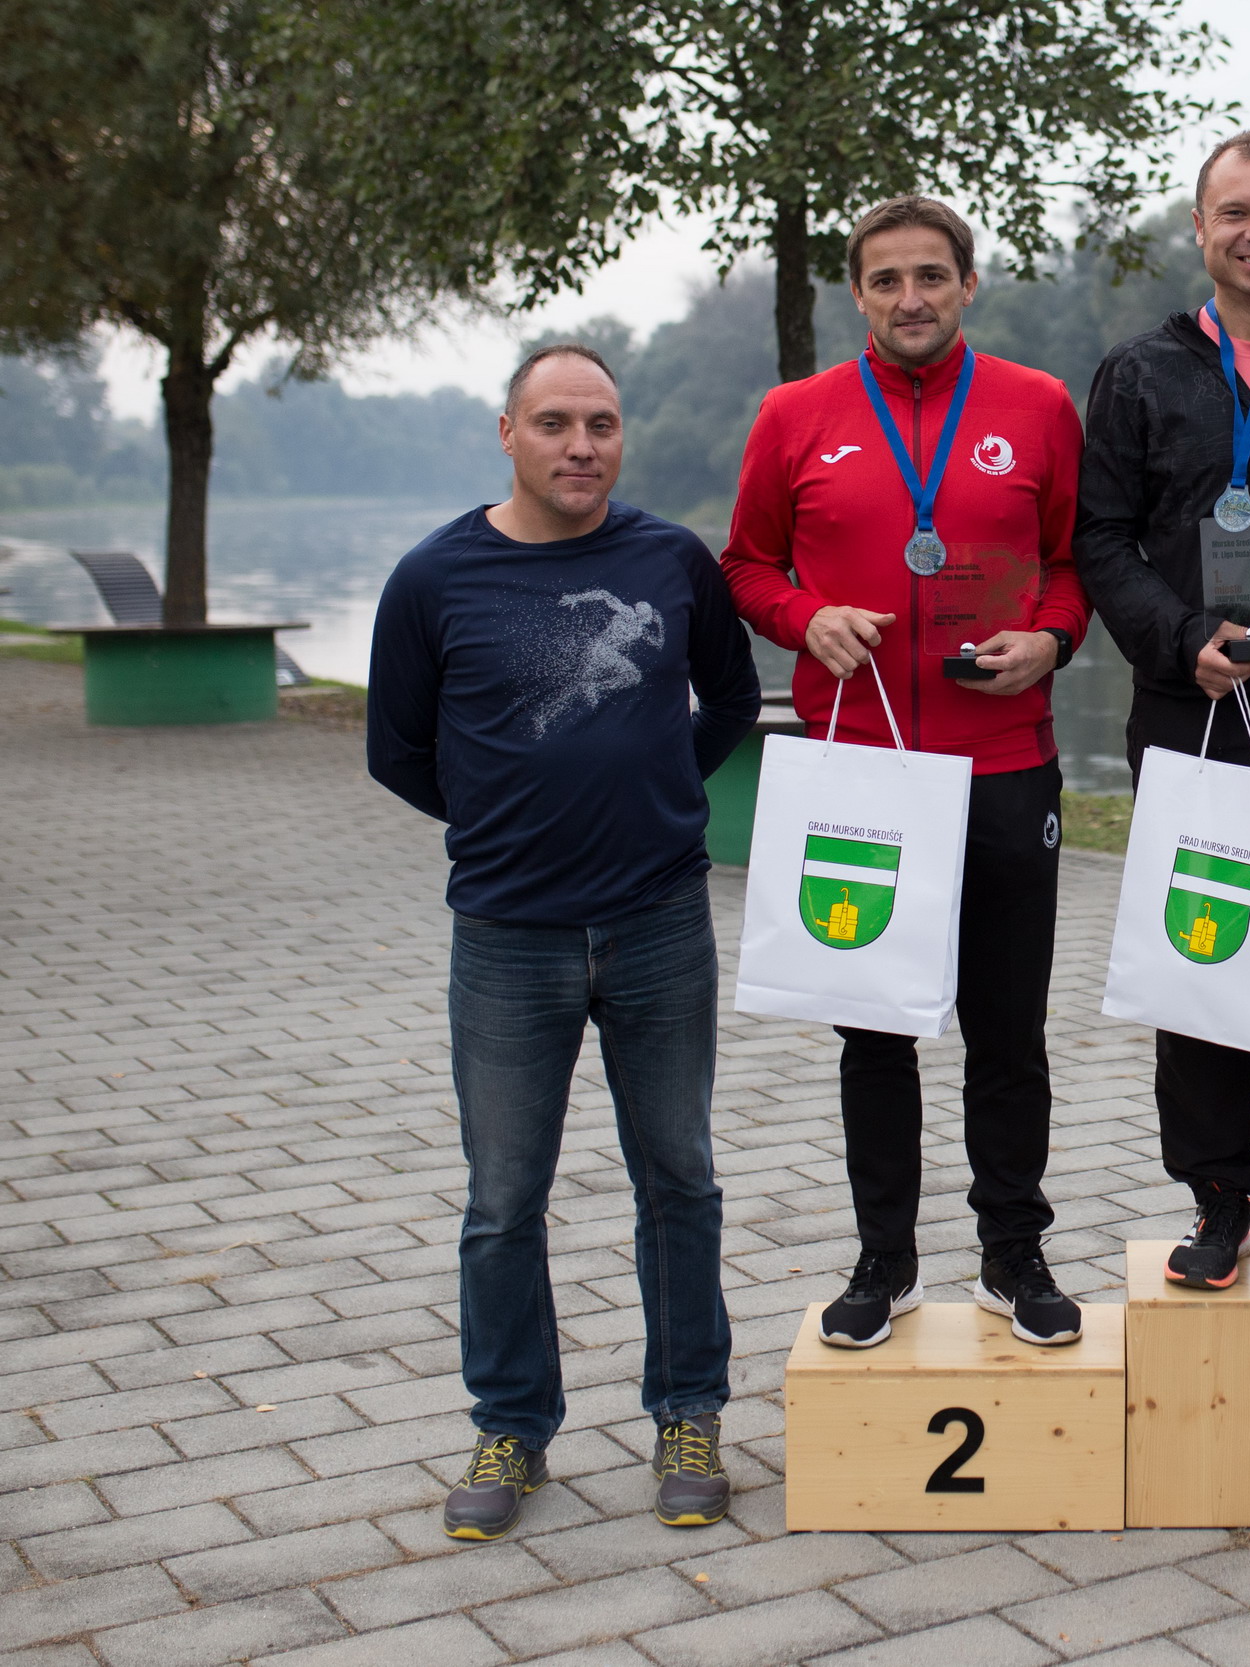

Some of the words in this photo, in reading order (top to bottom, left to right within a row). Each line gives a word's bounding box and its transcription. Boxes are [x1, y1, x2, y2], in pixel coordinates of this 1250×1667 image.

[808, 821, 830, 833] GRAD
[831, 824, 865, 838] MURSKO
[867, 829, 904, 842] SREDIŠĆE
[1179, 834, 1199, 847] GRAD
[1200, 839, 1230, 855] MURSKO
[925, 1407, 985, 1494] 2
